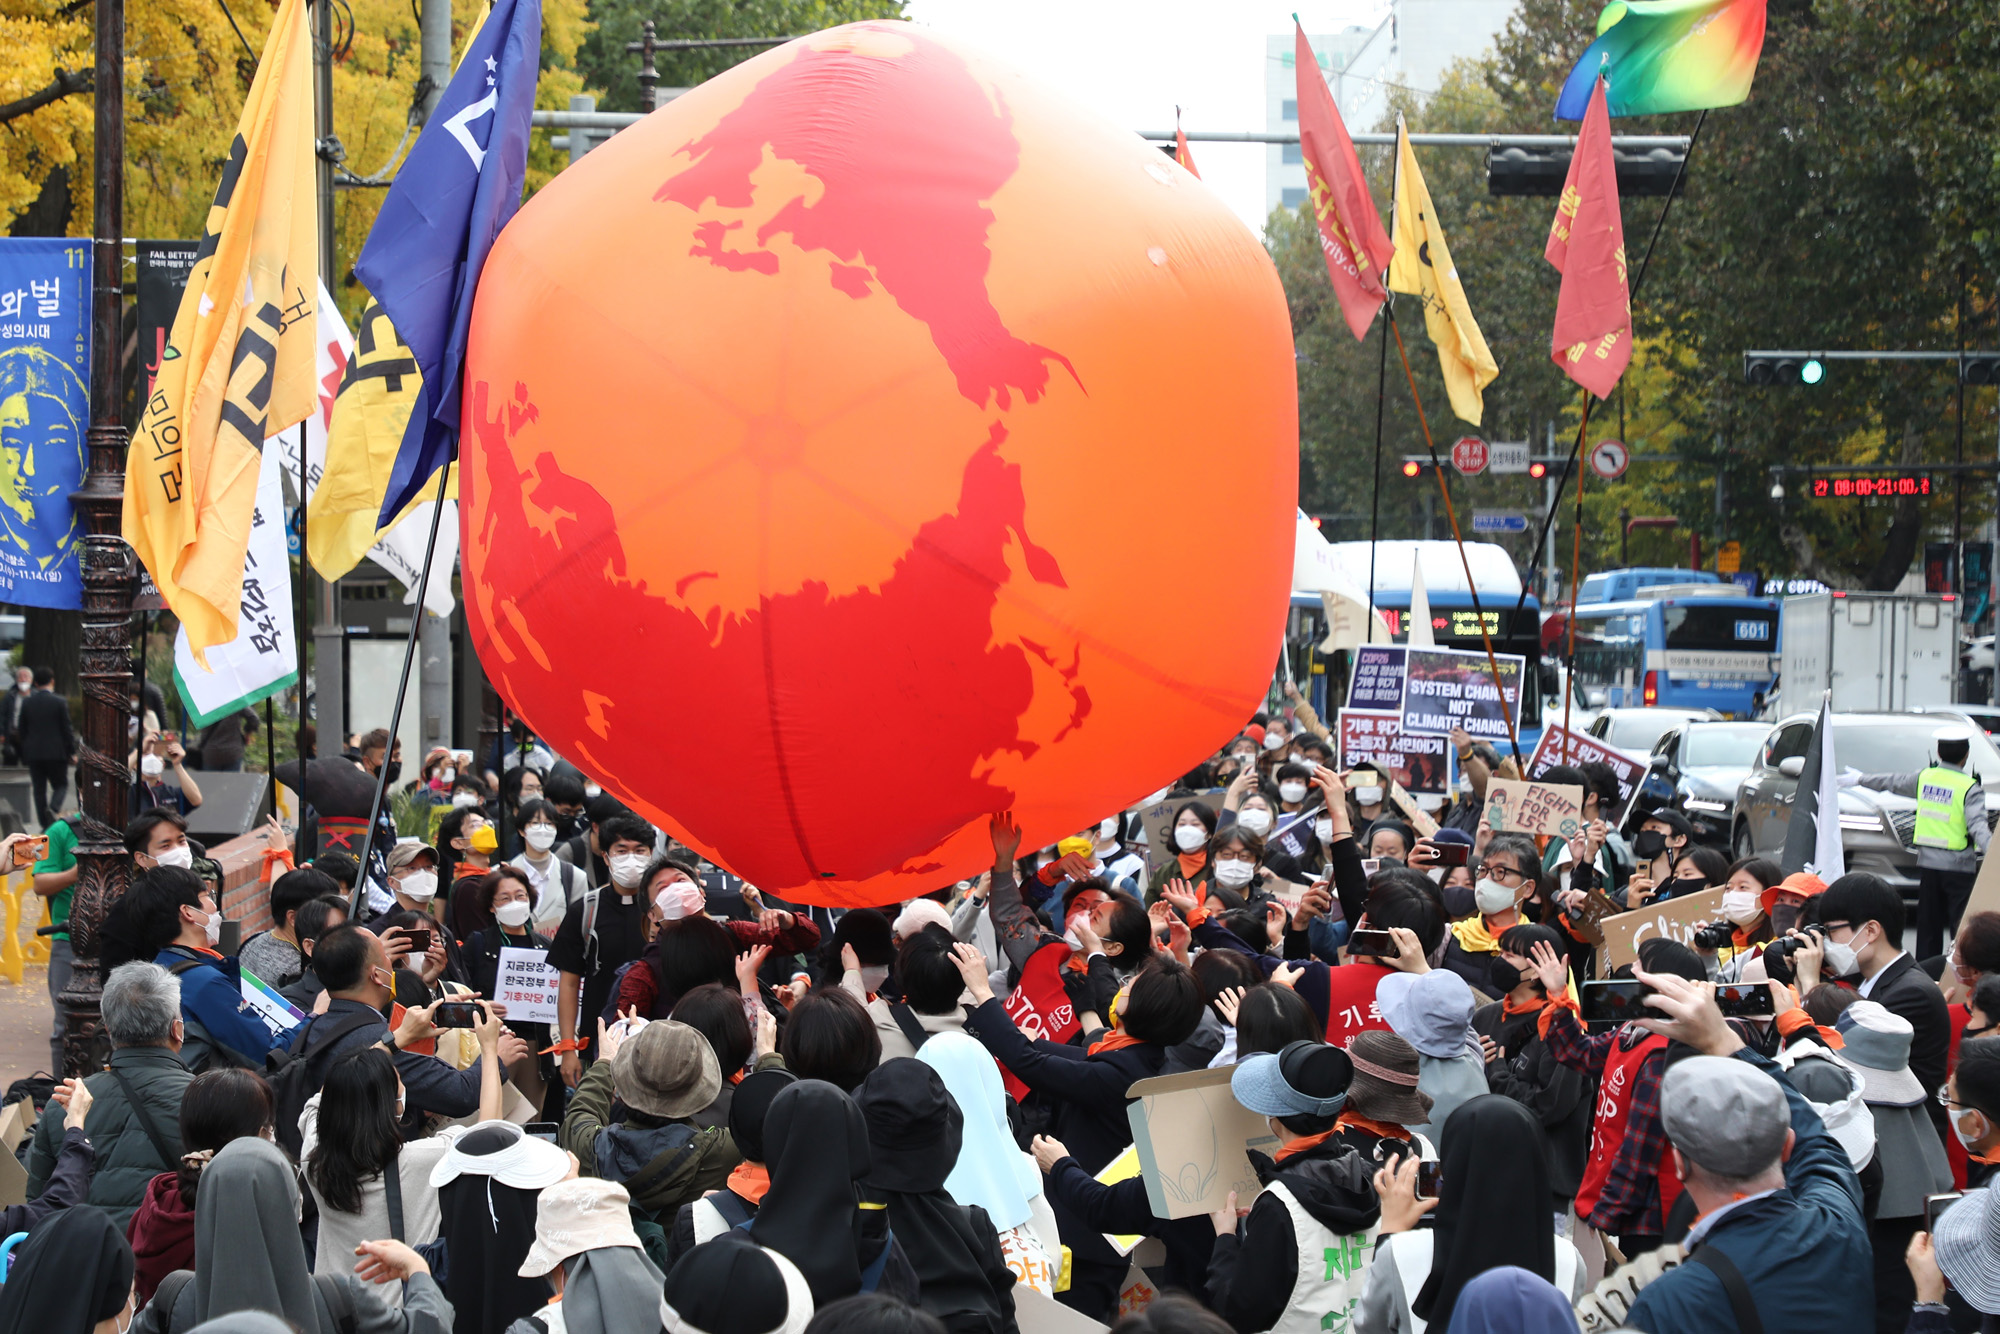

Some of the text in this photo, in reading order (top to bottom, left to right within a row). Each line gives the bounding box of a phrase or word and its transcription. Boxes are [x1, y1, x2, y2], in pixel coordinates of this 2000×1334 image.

[65, 248, 84, 268] 11
[150, 250, 166, 259] FAIL
[1457, 457, 1484, 469] STOP
[1739, 621, 1766, 639] 601
[1356, 676, 1397, 689] 기후 위기
[1410, 679, 1462, 700] SYSTEM
[1448, 699, 1475, 716] NOT
[1346, 717, 1374, 734] 기후
[1406, 712, 1514, 736] CLIMATE CHANG
[1346, 734, 1388, 752] 노동자
[1526, 784, 1578, 816] FIGHT
[1520, 798, 1550, 822] FOR
[505, 960, 546, 973] 지금당장
[505, 975, 545, 988] 한국정부
[503, 991, 544, 1004] 기후악당
